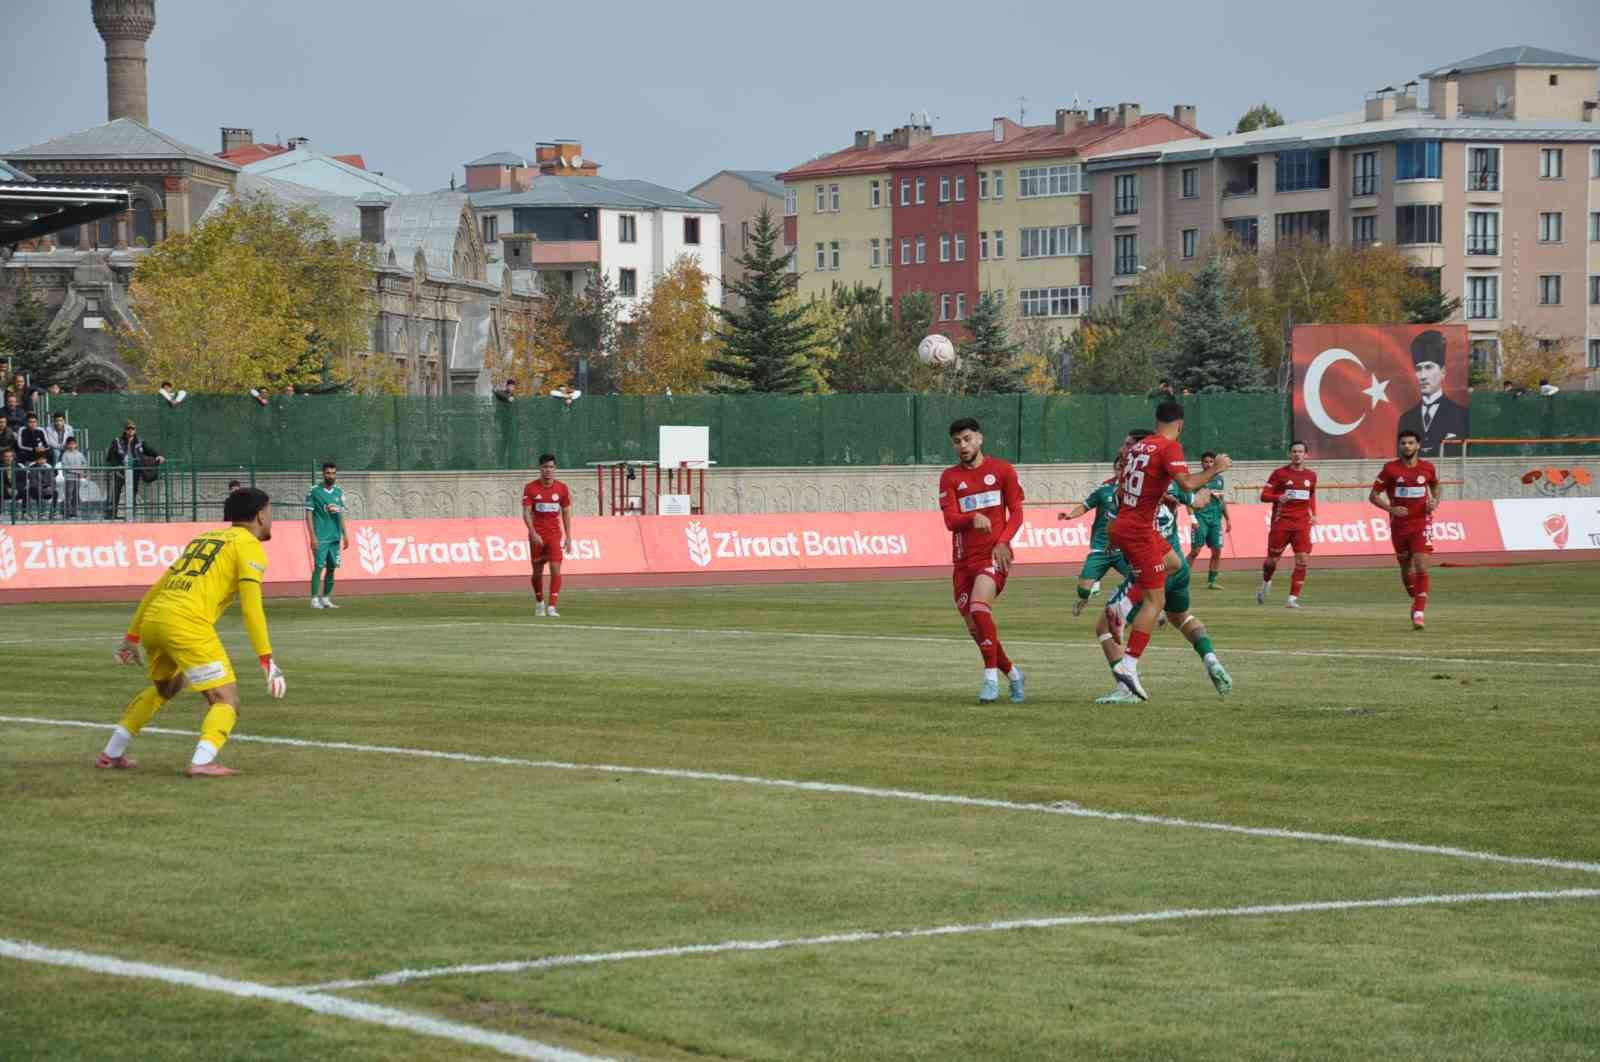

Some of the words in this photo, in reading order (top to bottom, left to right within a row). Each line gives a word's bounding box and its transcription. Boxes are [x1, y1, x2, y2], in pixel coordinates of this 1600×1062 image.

[20, 539, 128, 570] Ziraat
[385, 535, 483, 565] Ziraat
[713, 530, 801, 558] Ziraat
[803, 530, 908, 557] Bankası
